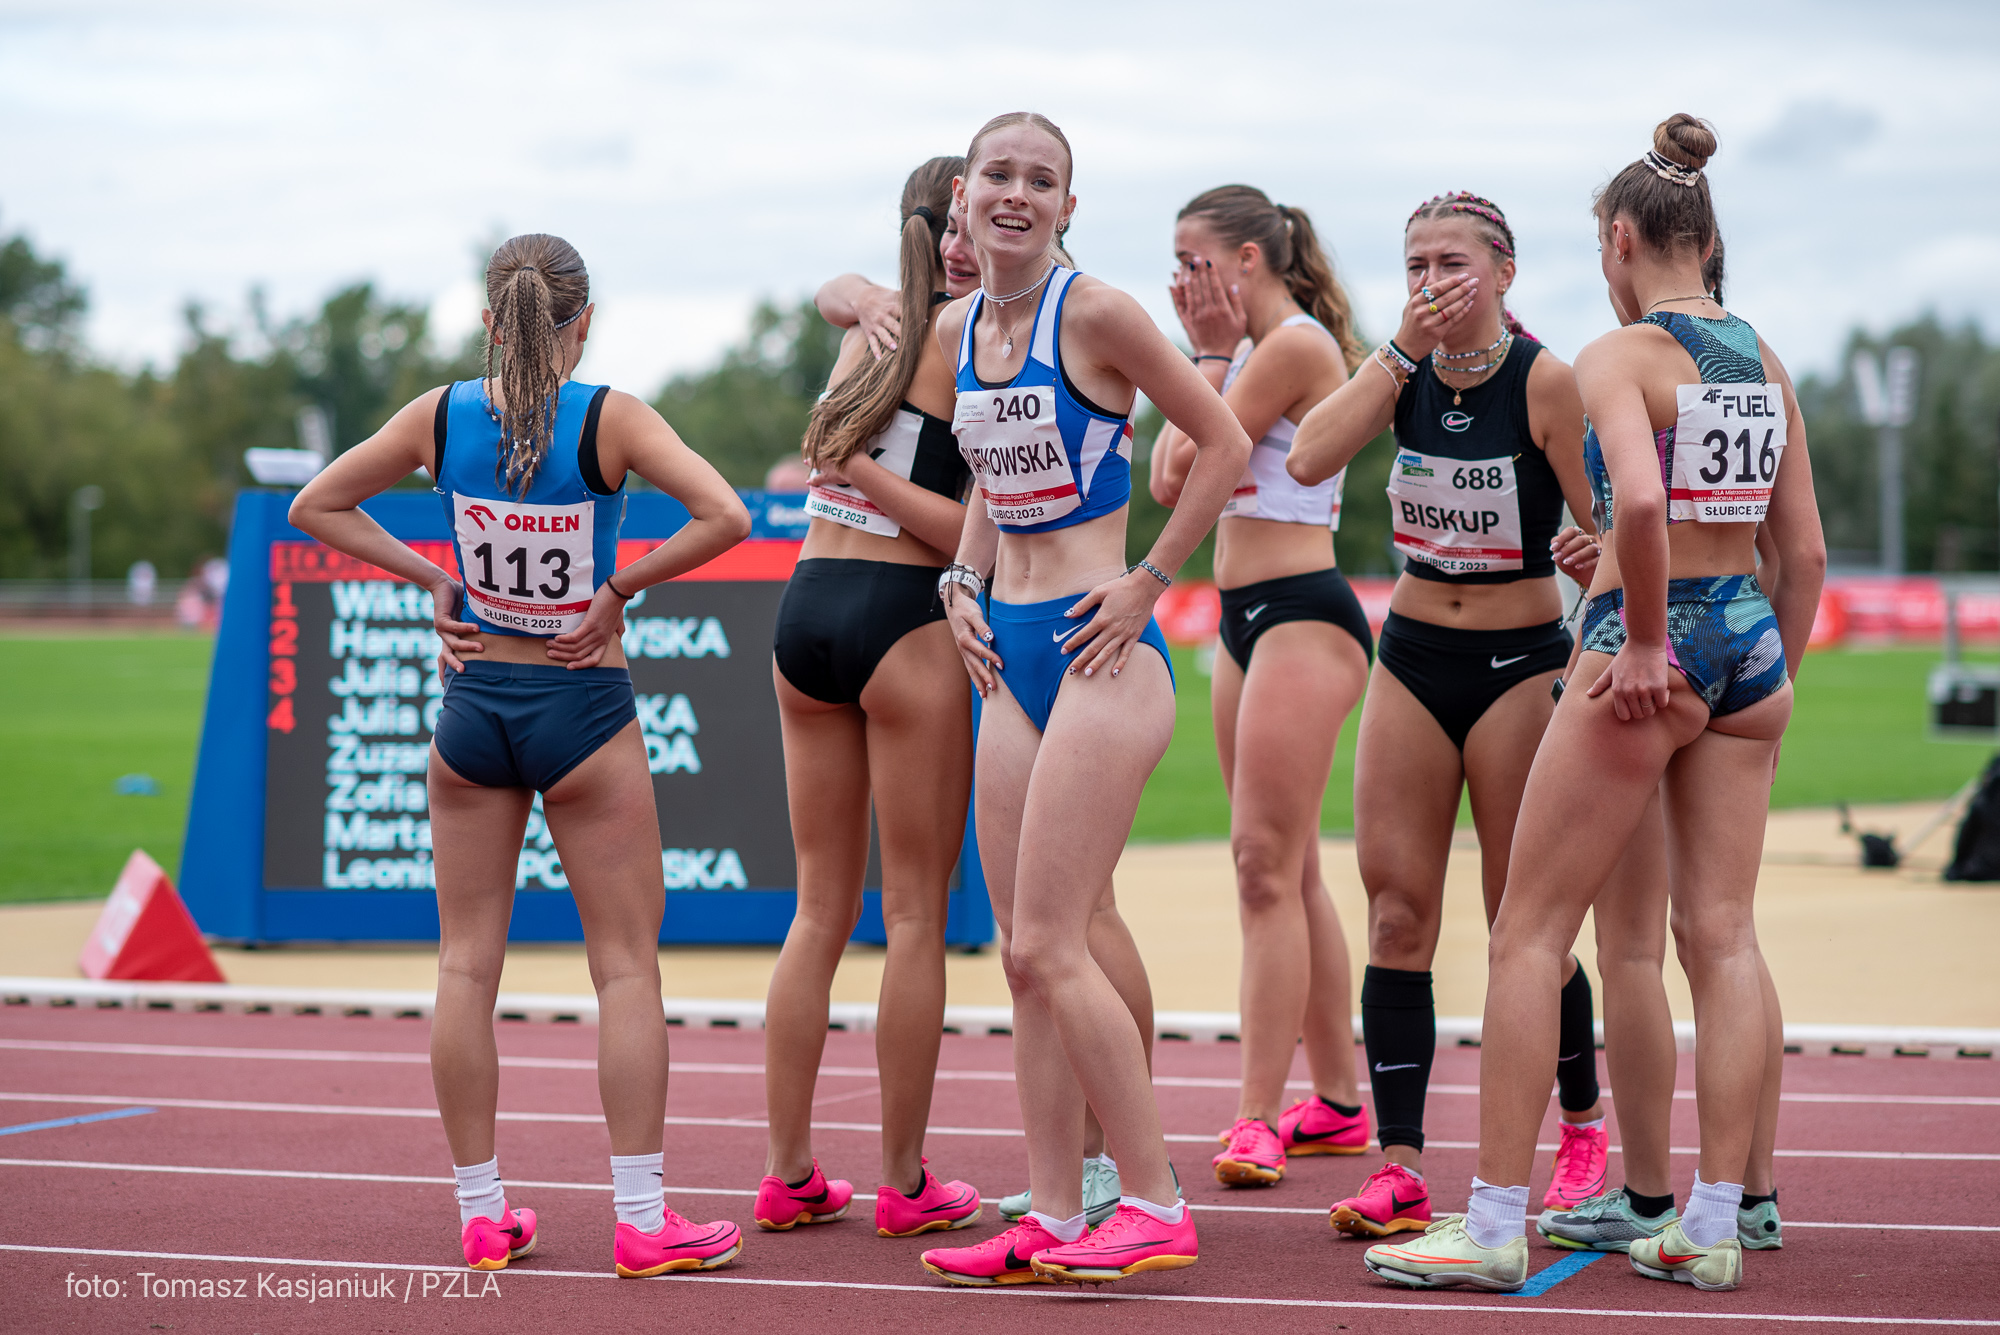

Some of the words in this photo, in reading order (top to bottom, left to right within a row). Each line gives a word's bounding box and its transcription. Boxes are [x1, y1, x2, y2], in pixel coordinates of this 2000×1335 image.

[993, 394, 1041, 422] 240
[1722, 395, 1775, 418] FUEL
[1699, 428, 1776, 484] 316
[1452, 466, 1504, 491] 688
[504, 513, 580, 533] ORLEN
[810, 500, 844, 518] SŁUBICE
[844, 511, 867, 525] 2023
[1015, 506, 1045, 520] 2023
[1400, 500, 1500, 535] BISKUP
[1705, 505, 1752, 516] SŁUBICE
[473, 542, 571, 600] 113
[1459, 561, 1488, 571] 2023
[272, 582, 298, 618] 1
[487, 595, 499, 603] PZLA
[498, 598, 529, 609] Mistrzostwa
[483, 608, 529, 627] SŁUBICE
[530, 619, 562, 629] 2023
[270, 619, 298, 656] 2
[269, 657, 298, 696] 3
[328, 657, 422, 697] Julia
[267, 696, 297, 734] 4
[327, 696, 421, 736] Julia
[324, 772, 429, 812] Zofia
